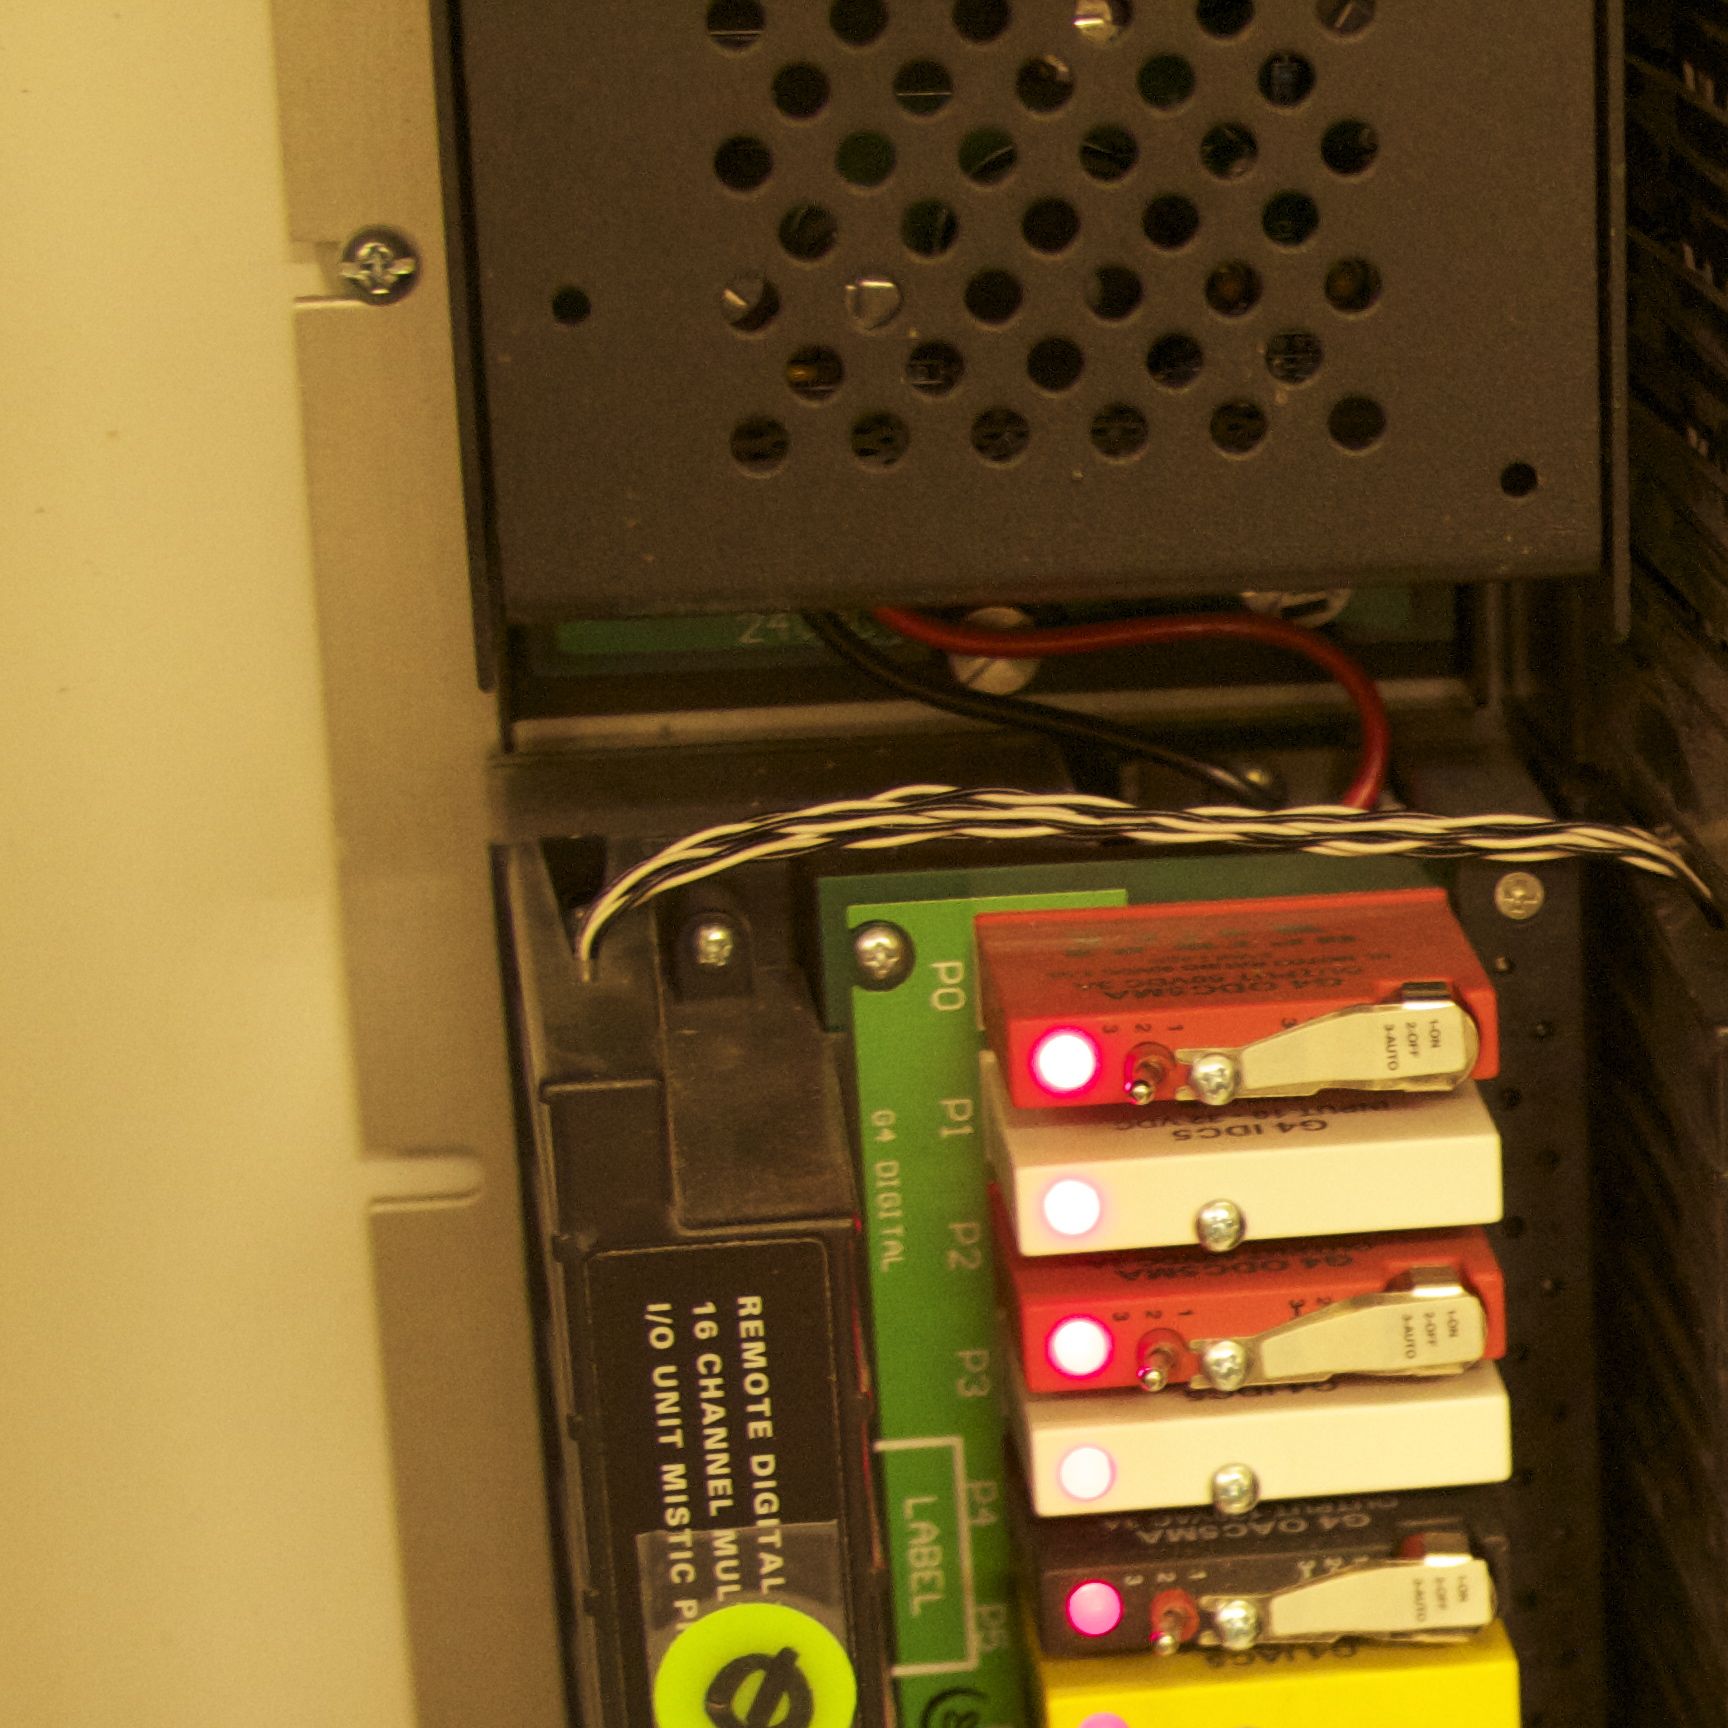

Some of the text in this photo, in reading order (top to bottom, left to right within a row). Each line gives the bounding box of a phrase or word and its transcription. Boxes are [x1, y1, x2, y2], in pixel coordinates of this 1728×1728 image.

[930, 959, 966, 1012] P0
[938, 1099, 974, 1140] P1
[1279, 1119, 1328, 1134] G4
[871, 1109, 905, 1274] G4 DIGITAL
[947, 1221, 982, 1272] P2
[692, 1301, 736, 1518] 16 CHANNEL
[956, 1350, 990, 1399] P3
[645, 1303, 695, 1585] I/O UNIT MISTIC
[737, 1296, 786, 1595] REMOTE DIGITAL
[902, 1494, 945, 1617] LABEL
